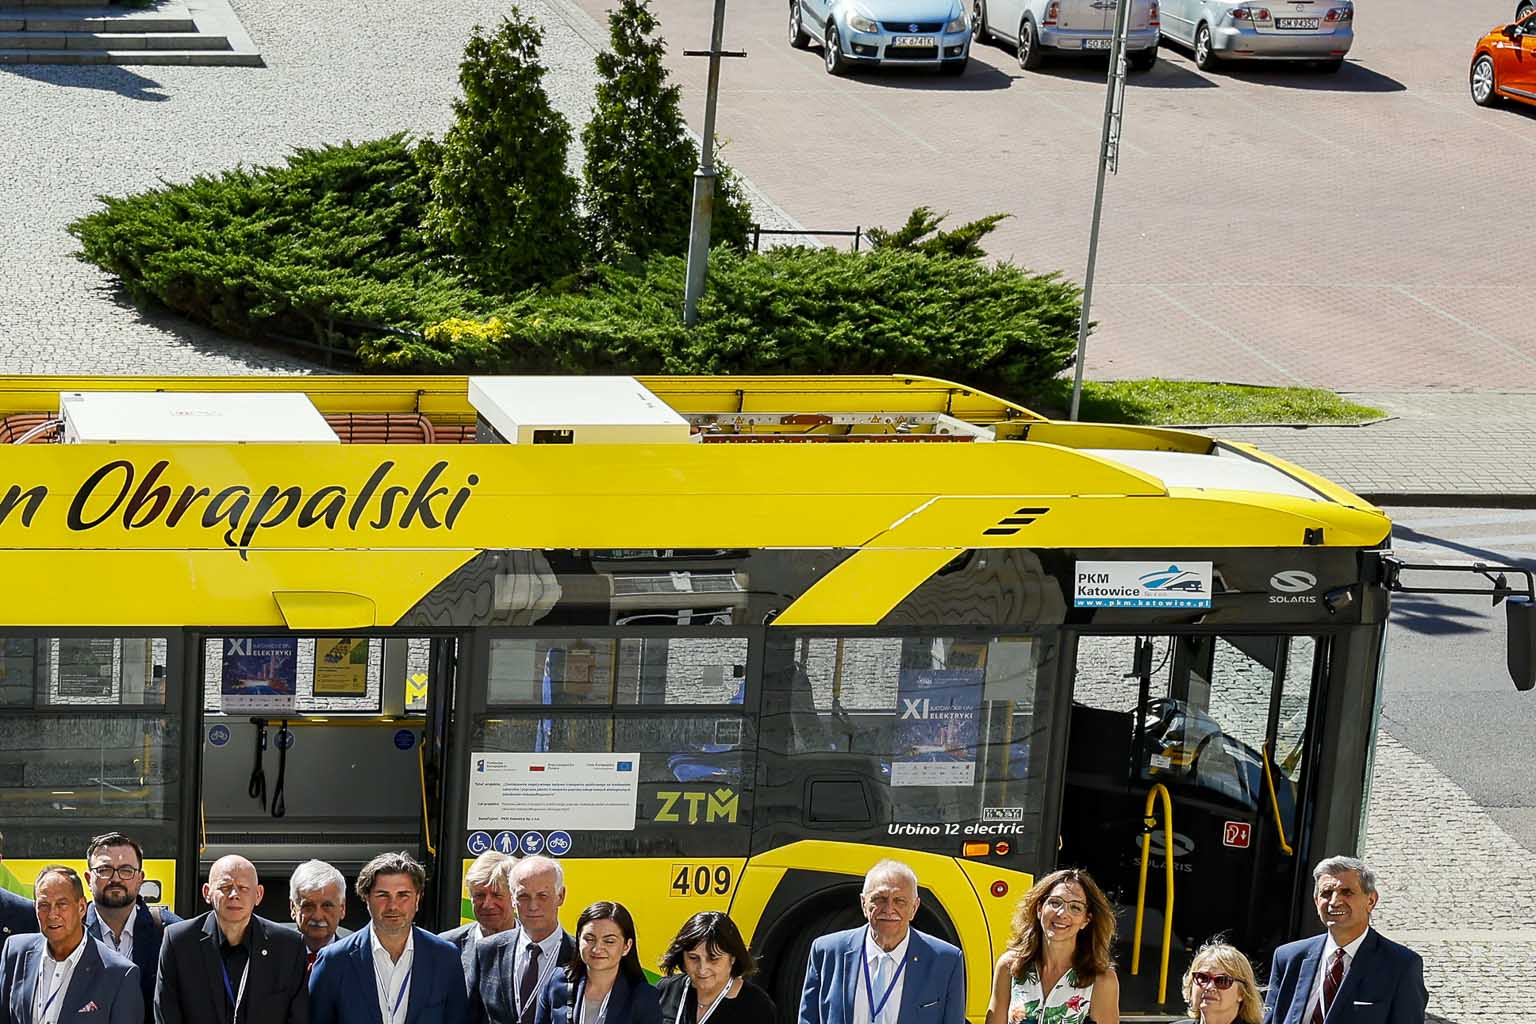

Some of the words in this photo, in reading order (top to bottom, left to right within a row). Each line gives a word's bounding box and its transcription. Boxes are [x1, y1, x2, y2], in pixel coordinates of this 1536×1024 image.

[66, 459, 480, 562] Obrąpalski
[1077, 573, 1110, 584] PKM
[1077, 585, 1141, 597] Katowice
[1076, 599, 1210, 608] www.pkm.katowice.pl
[1268, 595, 1317, 604] SOLARIS
[227, 638, 253, 656] XI
[901, 698, 930, 720] XI
[929, 712, 974, 720] ELEKTRYKI
[654, 788, 739, 825] ZTM
[887, 823, 941, 835] Urbino
[944, 823, 961, 835] 12
[963, 822, 1025, 835] electric
[1133, 857, 1193, 872] SLARIS
[672, 864, 732, 896] 409
